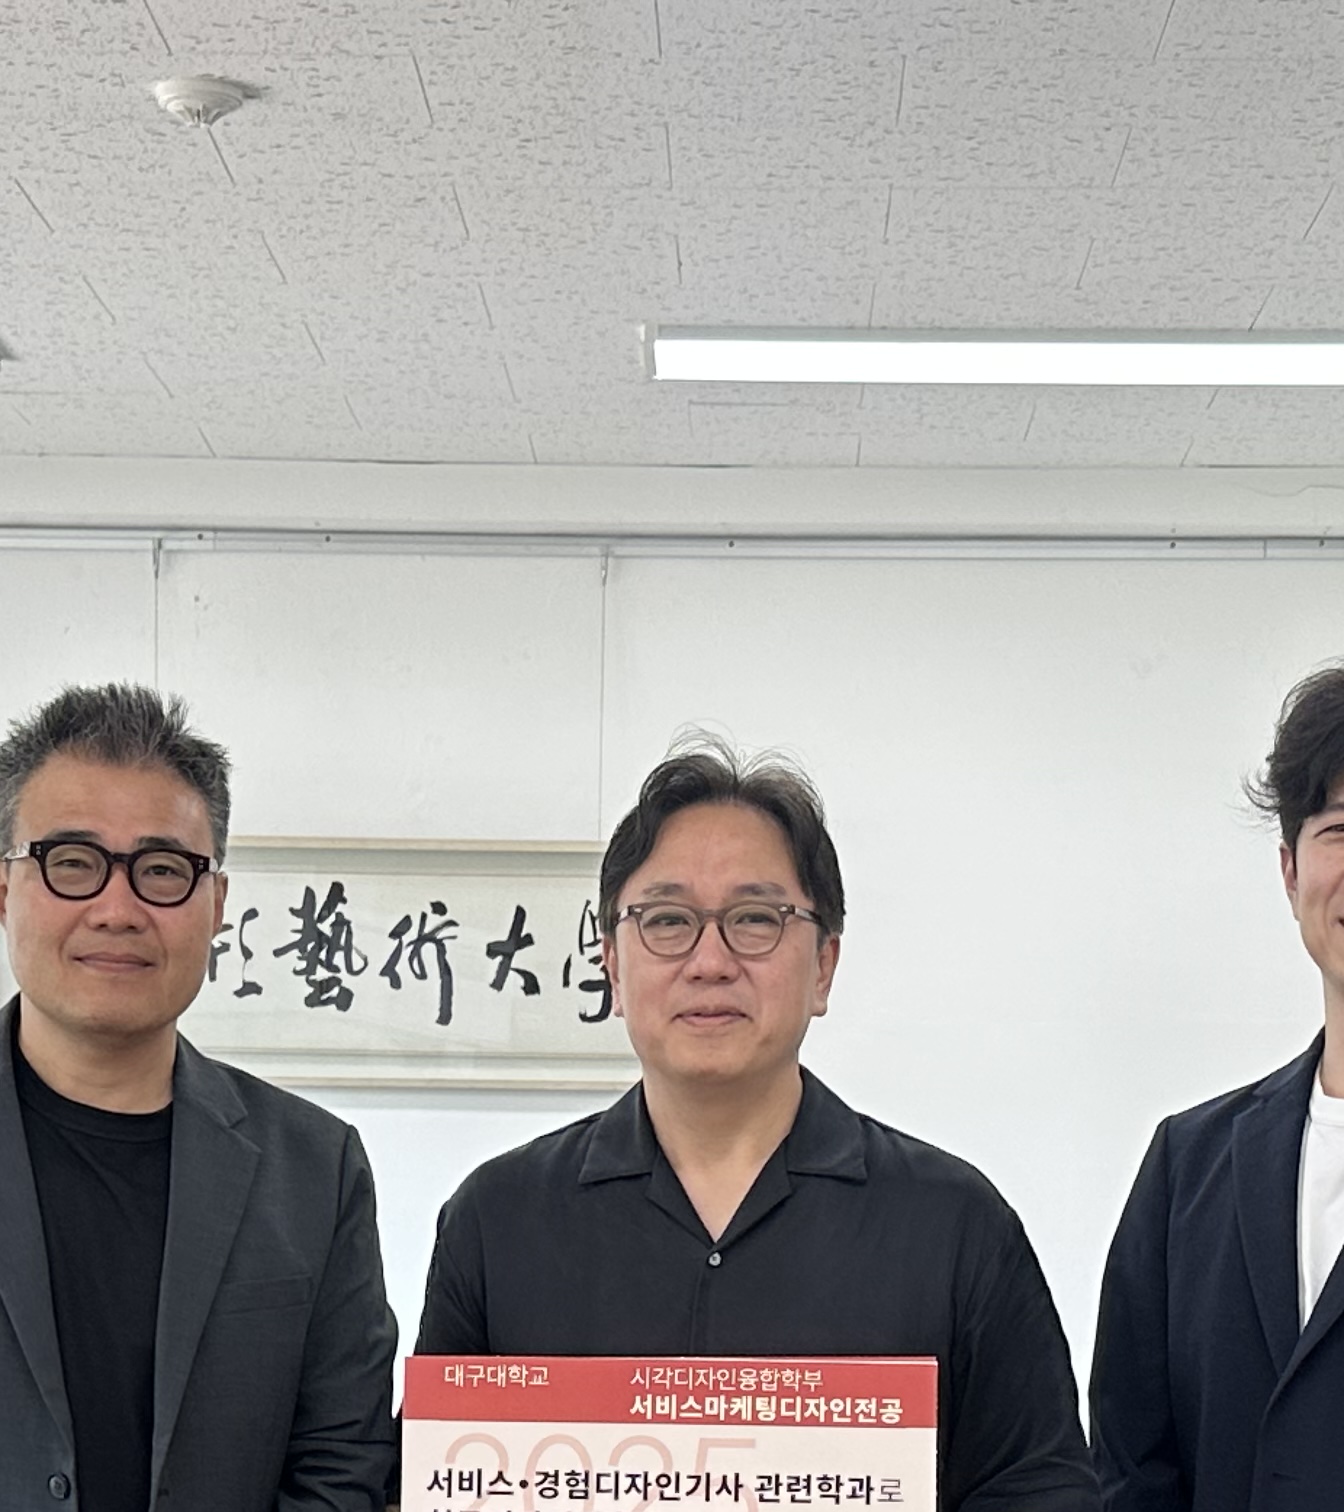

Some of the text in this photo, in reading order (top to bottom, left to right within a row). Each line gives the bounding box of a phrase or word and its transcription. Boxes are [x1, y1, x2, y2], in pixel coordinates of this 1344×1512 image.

[444, 1364, 549, 1387] 대구대학교
[630, 1366, 823, 1392] 시각디자인융합학부
[630, 1394, 903, 1424] 서비스마케팅디자인전공
[753, 1474, 903, 1506] 관련학과로
